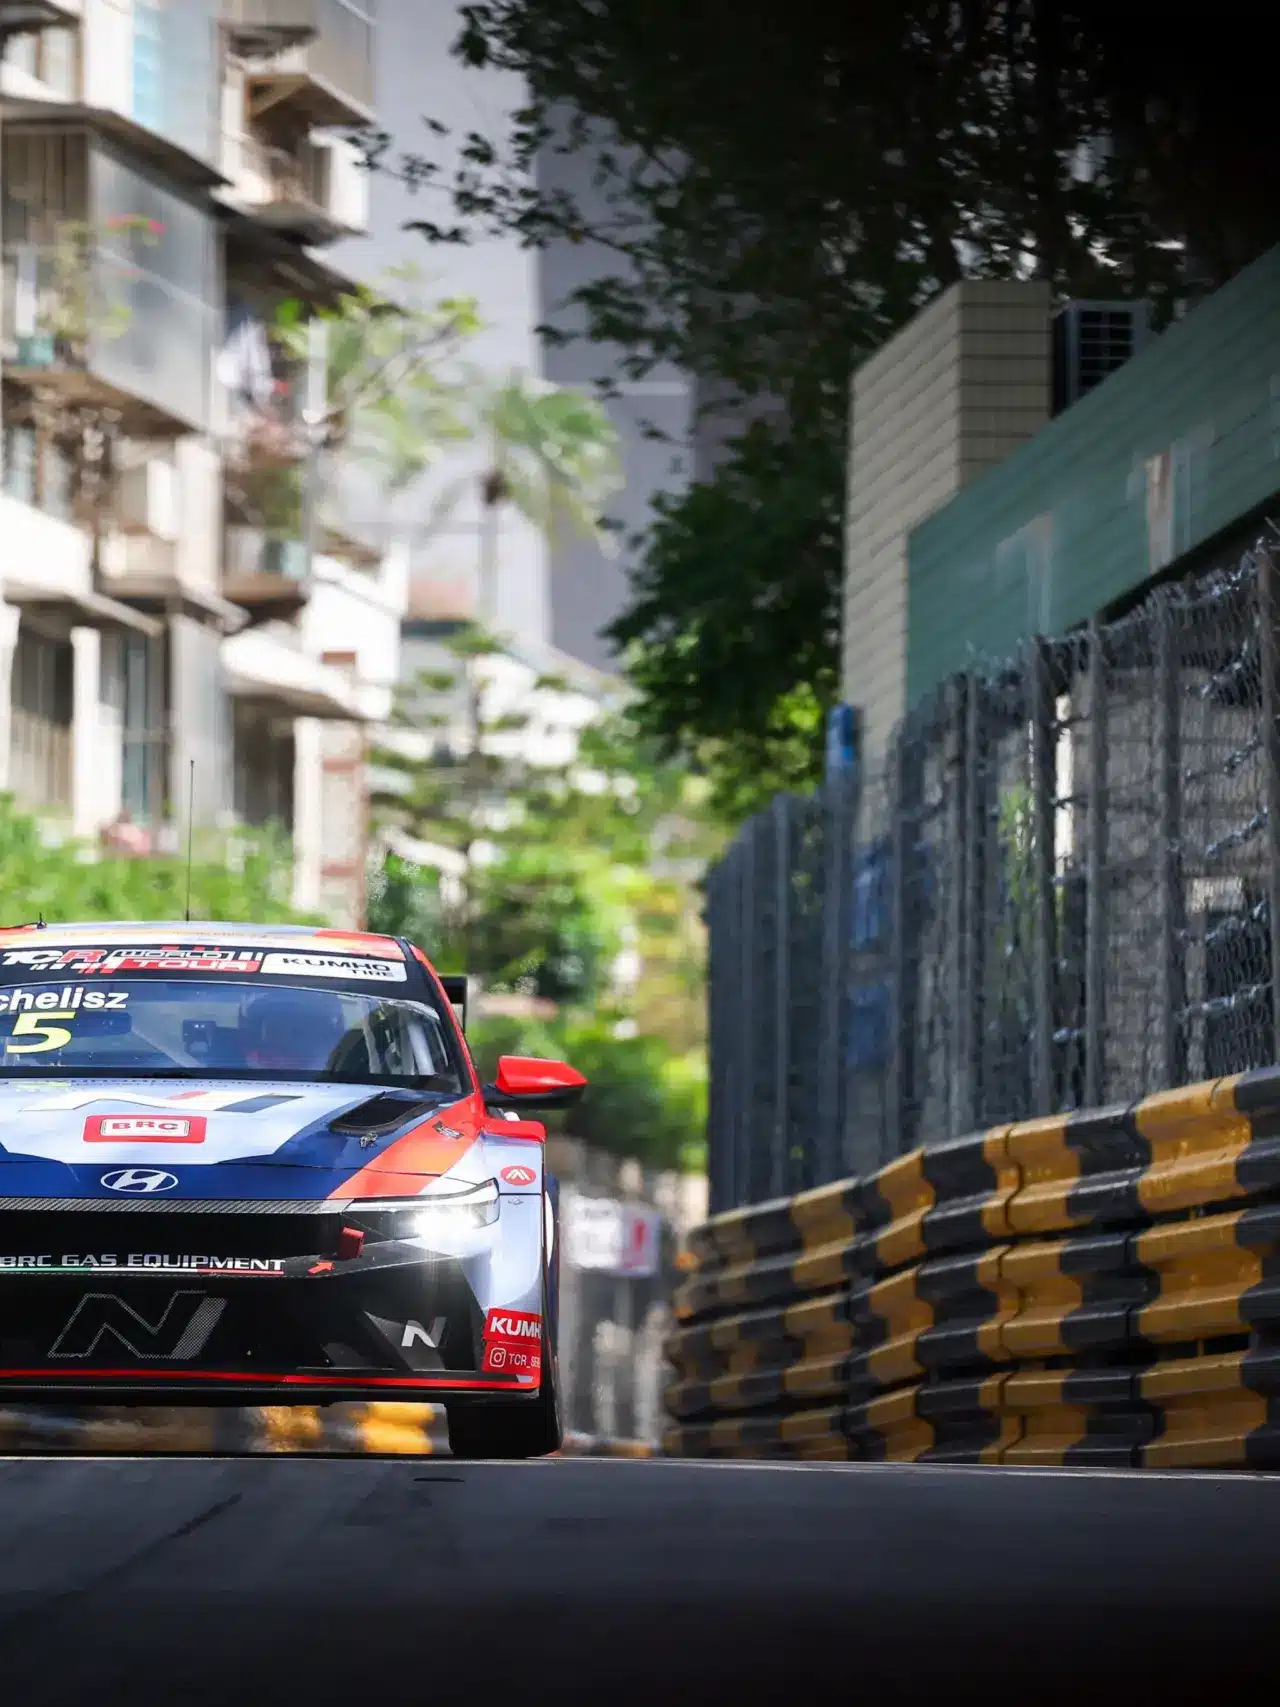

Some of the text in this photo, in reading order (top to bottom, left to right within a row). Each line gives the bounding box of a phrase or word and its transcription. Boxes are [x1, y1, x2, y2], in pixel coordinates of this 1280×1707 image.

[133, 959, 248, 970] TOUR
[283, 957, 390, 971] KUMHO
[350, 969, 394, 977] TIRE
[111, 1121, 178, 1130] BRC
[61, 1254, 117, 1267] GAS
[127, 1254, 285, 1270] EQUIPMENT
[490, 1316, 541, 1339] KUMH
